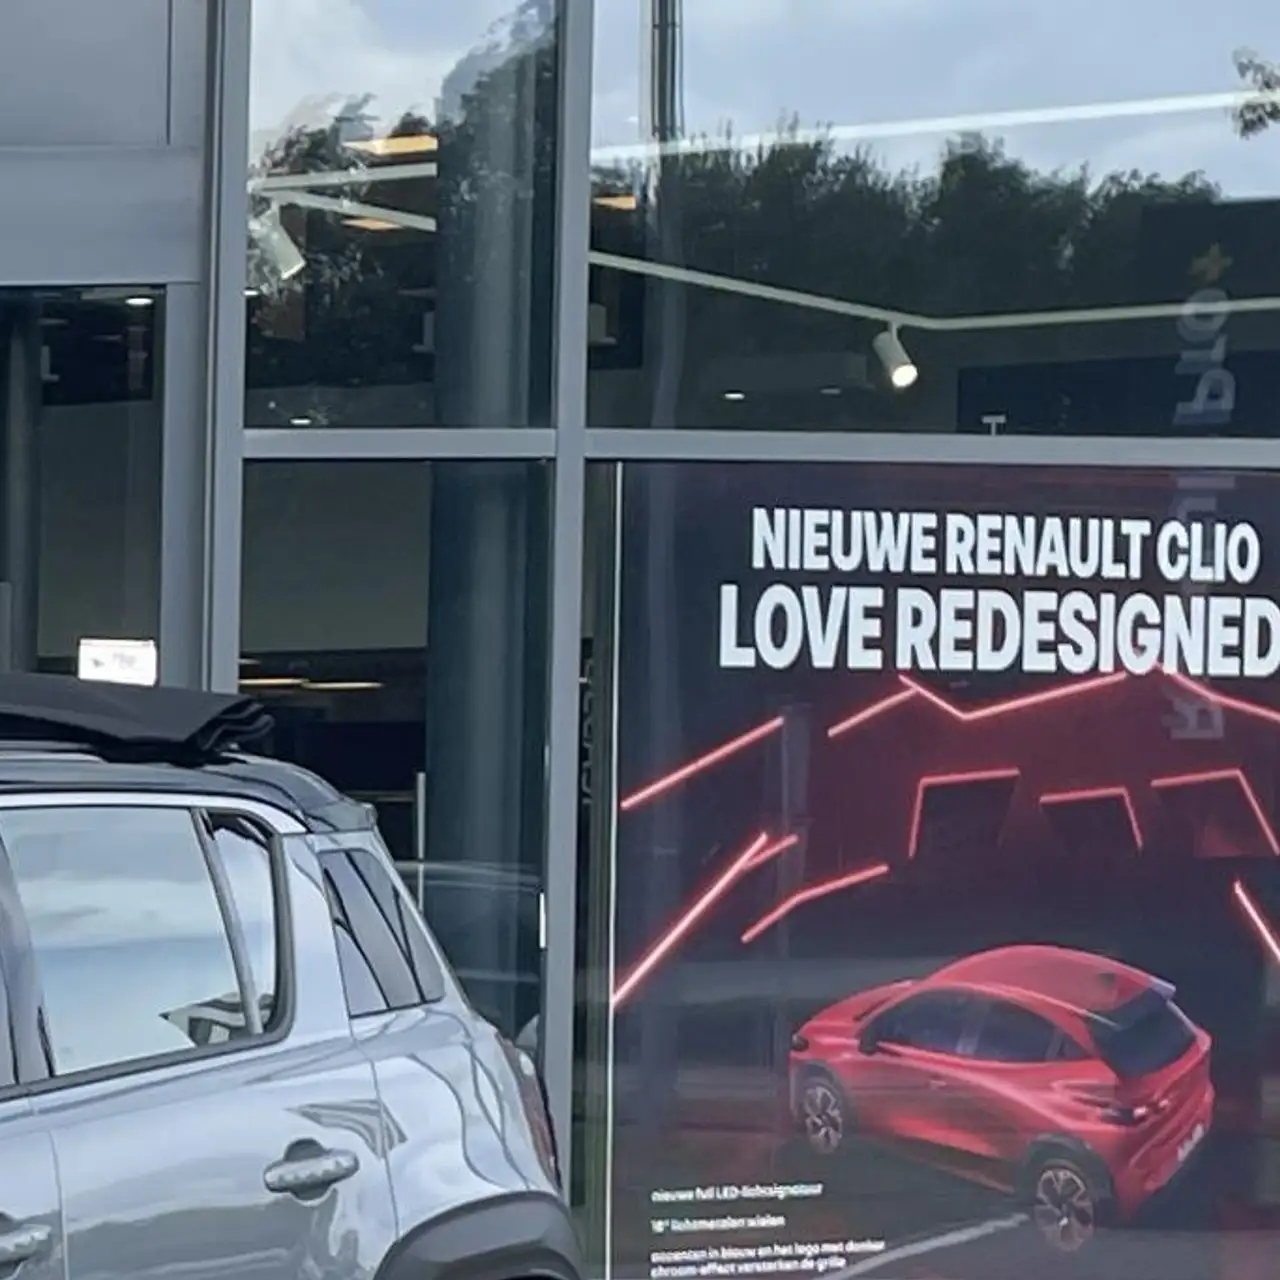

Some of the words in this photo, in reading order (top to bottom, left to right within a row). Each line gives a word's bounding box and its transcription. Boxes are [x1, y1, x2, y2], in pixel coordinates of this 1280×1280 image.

[752, 507, 938, 575] NIEUWE
[946, 512, 1151, 581] RENAULT
[1156, 520, 1261, 583] CLIO
[719, 584, 885, 671] LOVE
[896, 587, 1280, 678] REDESIGNED
